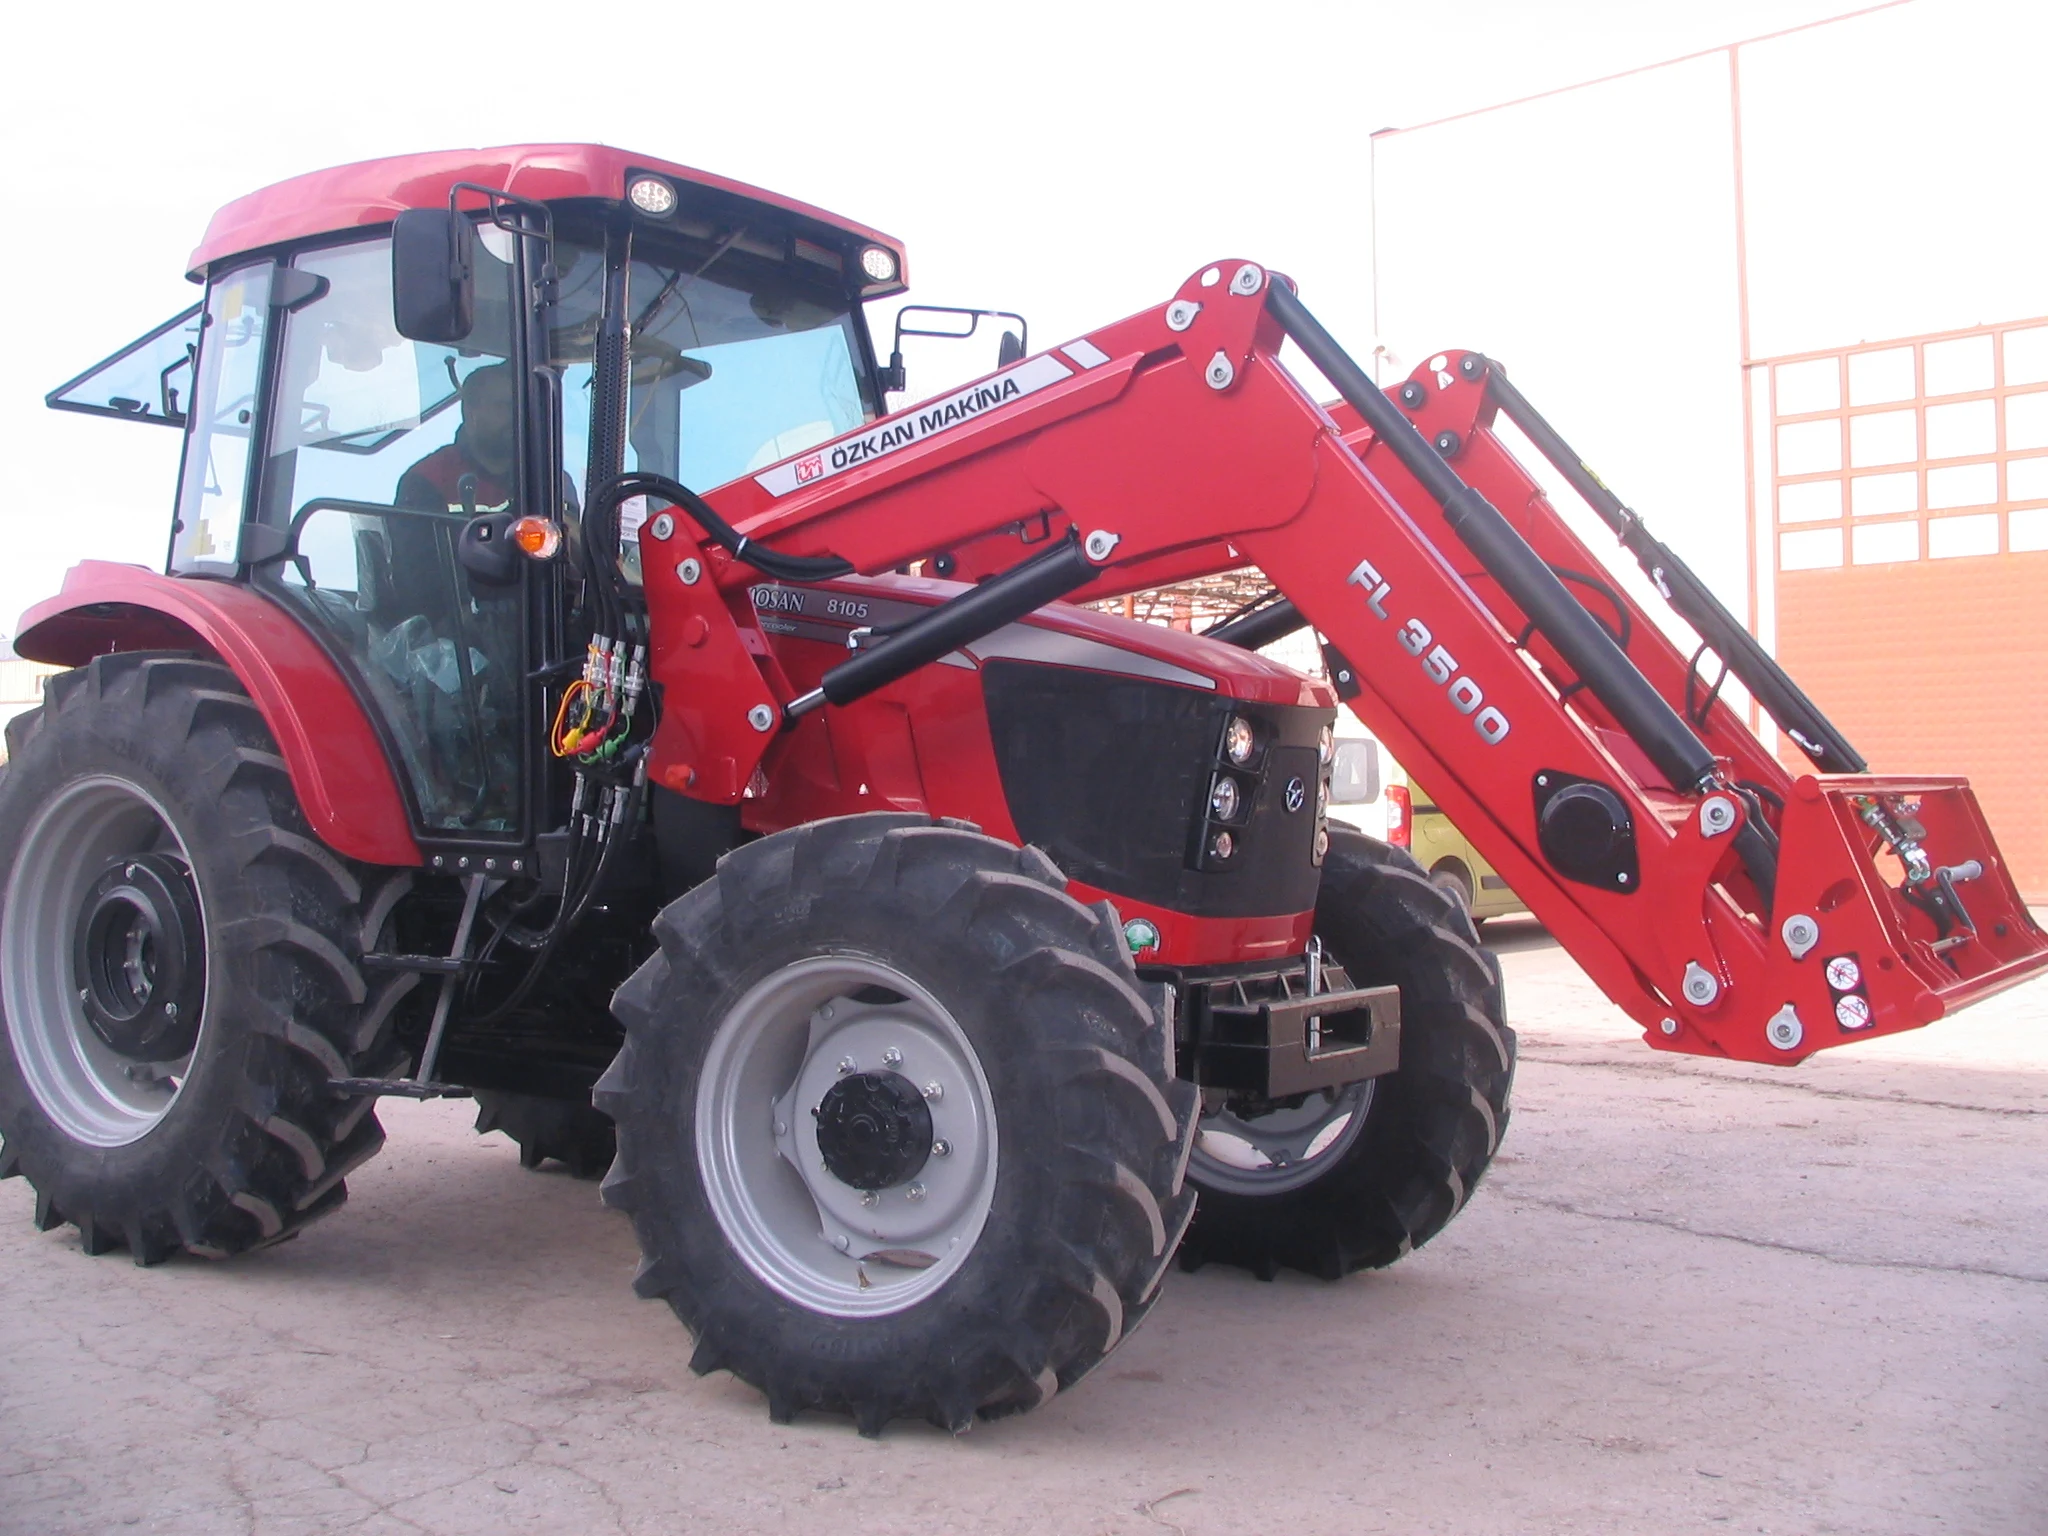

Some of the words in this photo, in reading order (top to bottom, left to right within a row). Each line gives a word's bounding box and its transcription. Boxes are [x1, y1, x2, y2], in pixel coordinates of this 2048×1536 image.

[831, 420, 914, 470] ÖZKAN
[919, 377, 1020, 435] MAKİNA
[827, 599, 868, 618] 8105
[1347, 559, 1391, 621] FL
[1397, 618, 1511, 746] 3500
